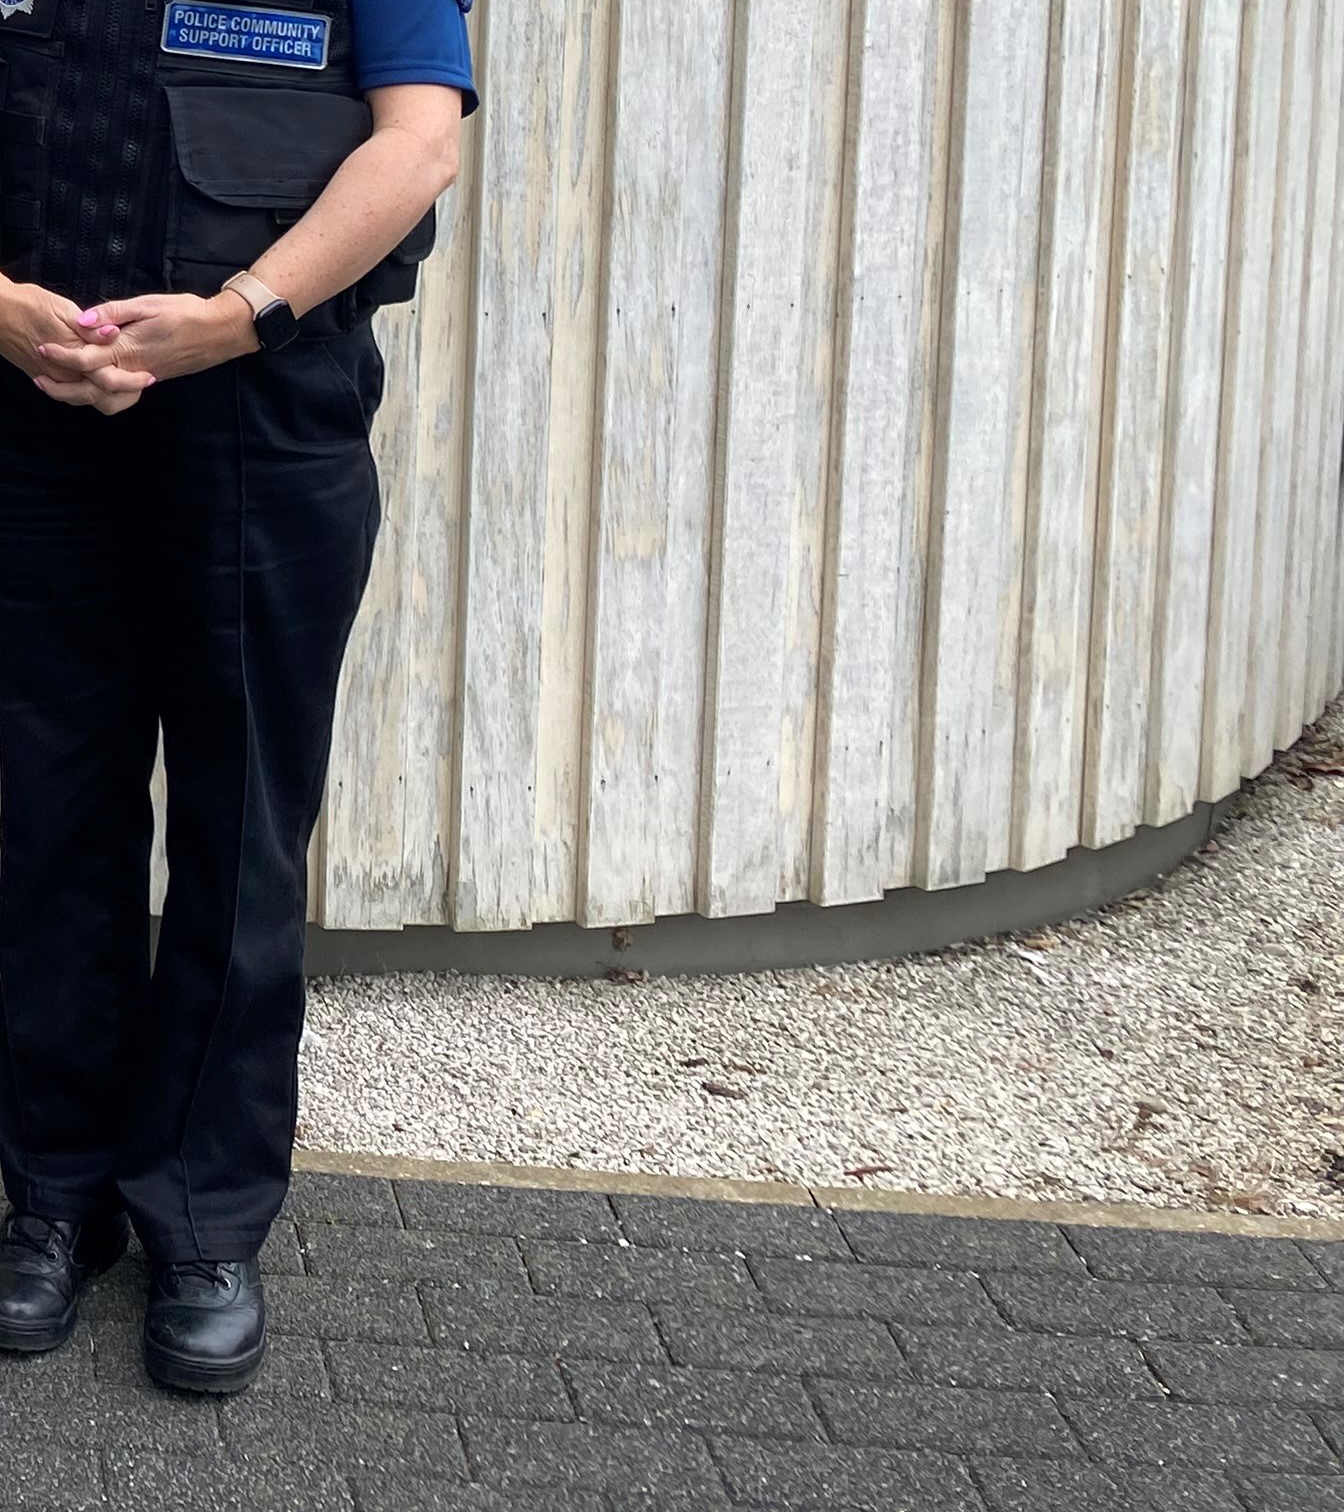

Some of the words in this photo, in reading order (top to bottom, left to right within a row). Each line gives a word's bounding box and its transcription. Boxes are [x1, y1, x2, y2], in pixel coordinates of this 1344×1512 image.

[174, 10, 227, 30] POLICE
[230, 16, 320, 39] COMMUNITY
[179, 28, 249, 49] SUPPORT
[252, 36, 312, 57] OFFICER
